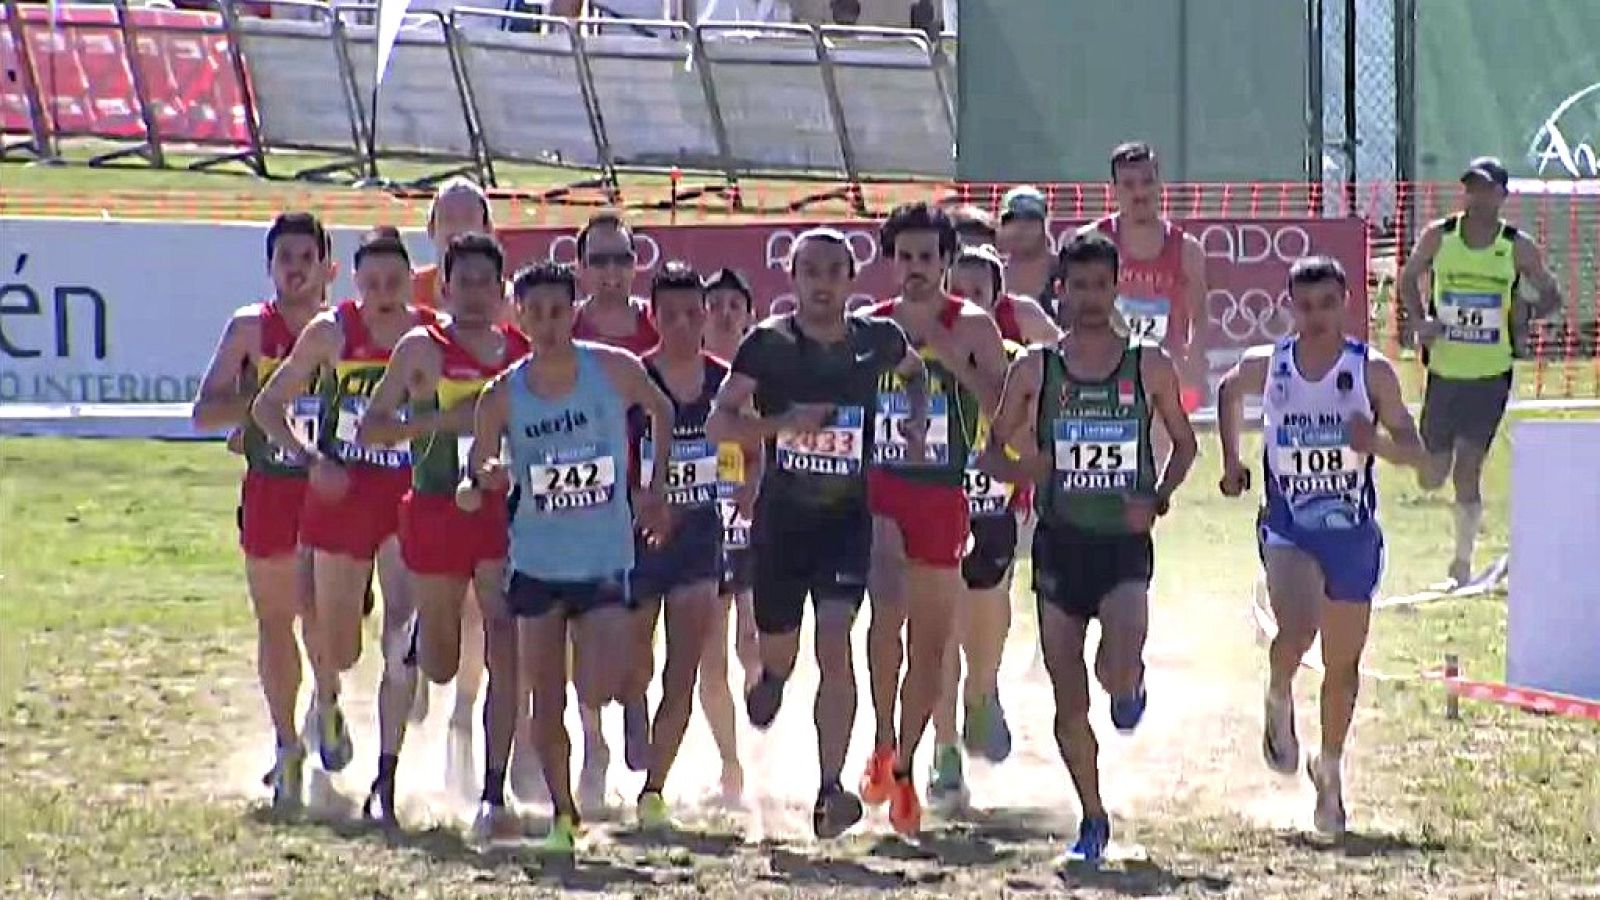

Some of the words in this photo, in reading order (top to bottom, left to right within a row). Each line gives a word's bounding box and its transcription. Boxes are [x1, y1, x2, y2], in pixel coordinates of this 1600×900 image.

[1536, 119, 1600, 178] An
[1201, 223, 1309, 264] ADO
[782, 453, 849, 475] Joma
[1069, 443, 1123, 469] 125
[1291, 450, 1343, 474] 108
[545, 463, 599, 490] 242
[1063, 473, 1127, 491] Joma
[543, 488, 609, 512] Joma
